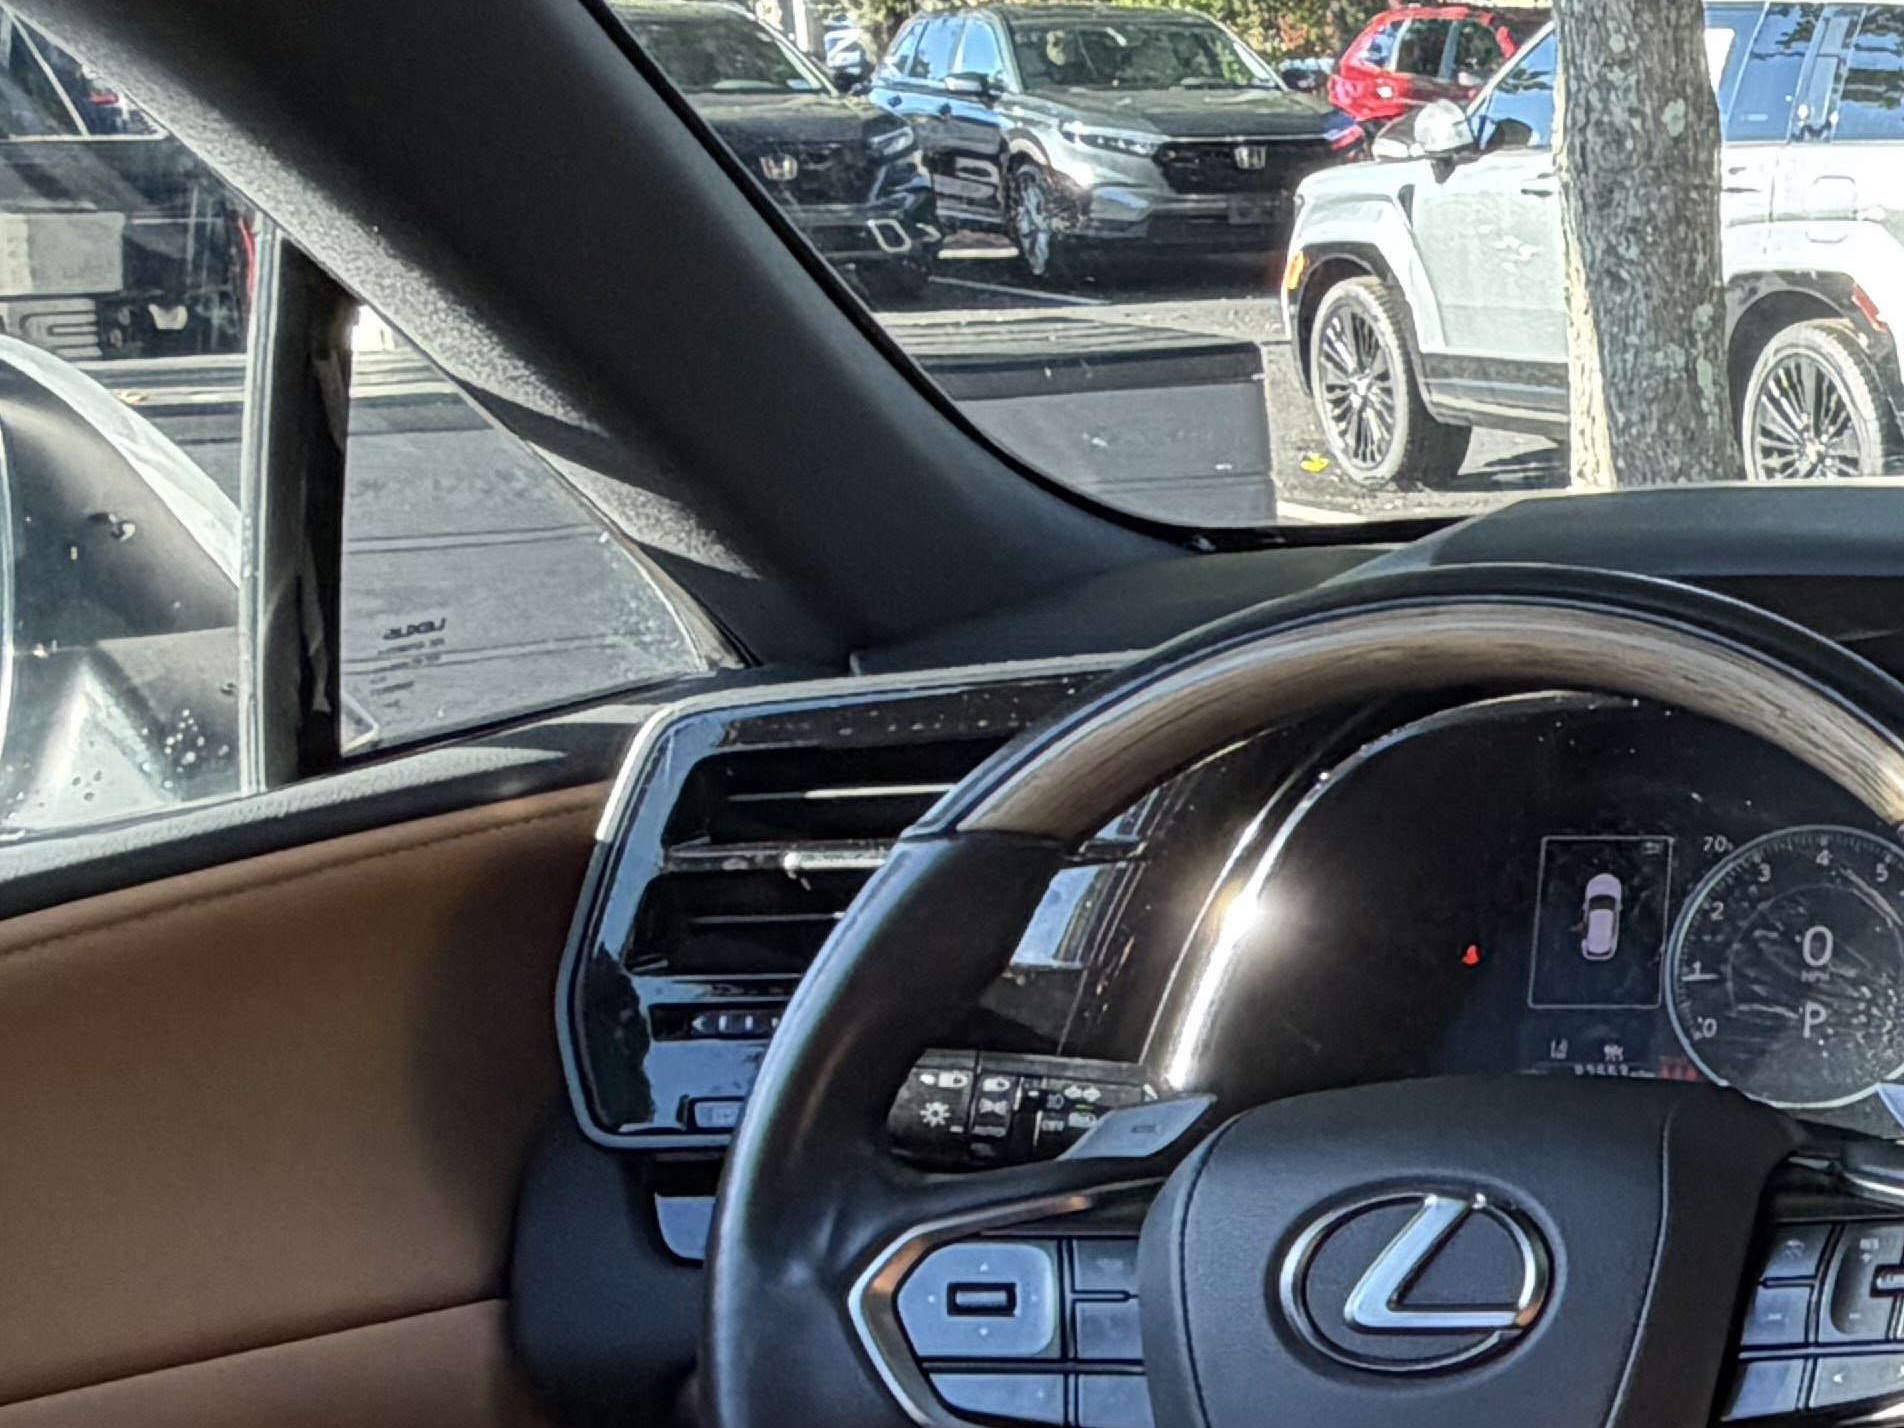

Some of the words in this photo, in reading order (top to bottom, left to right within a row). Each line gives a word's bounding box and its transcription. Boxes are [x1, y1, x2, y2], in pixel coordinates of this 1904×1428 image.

[1815, 849, 1832, 866] 4
[1758, 863, 1771, 883] 3
[1876, 864, 1889, 883] 5
[1712, 902, 1724, 921] 2
[1802, 925, 1834, 968] 0
[1803, 1002, 1826, 1039] P
